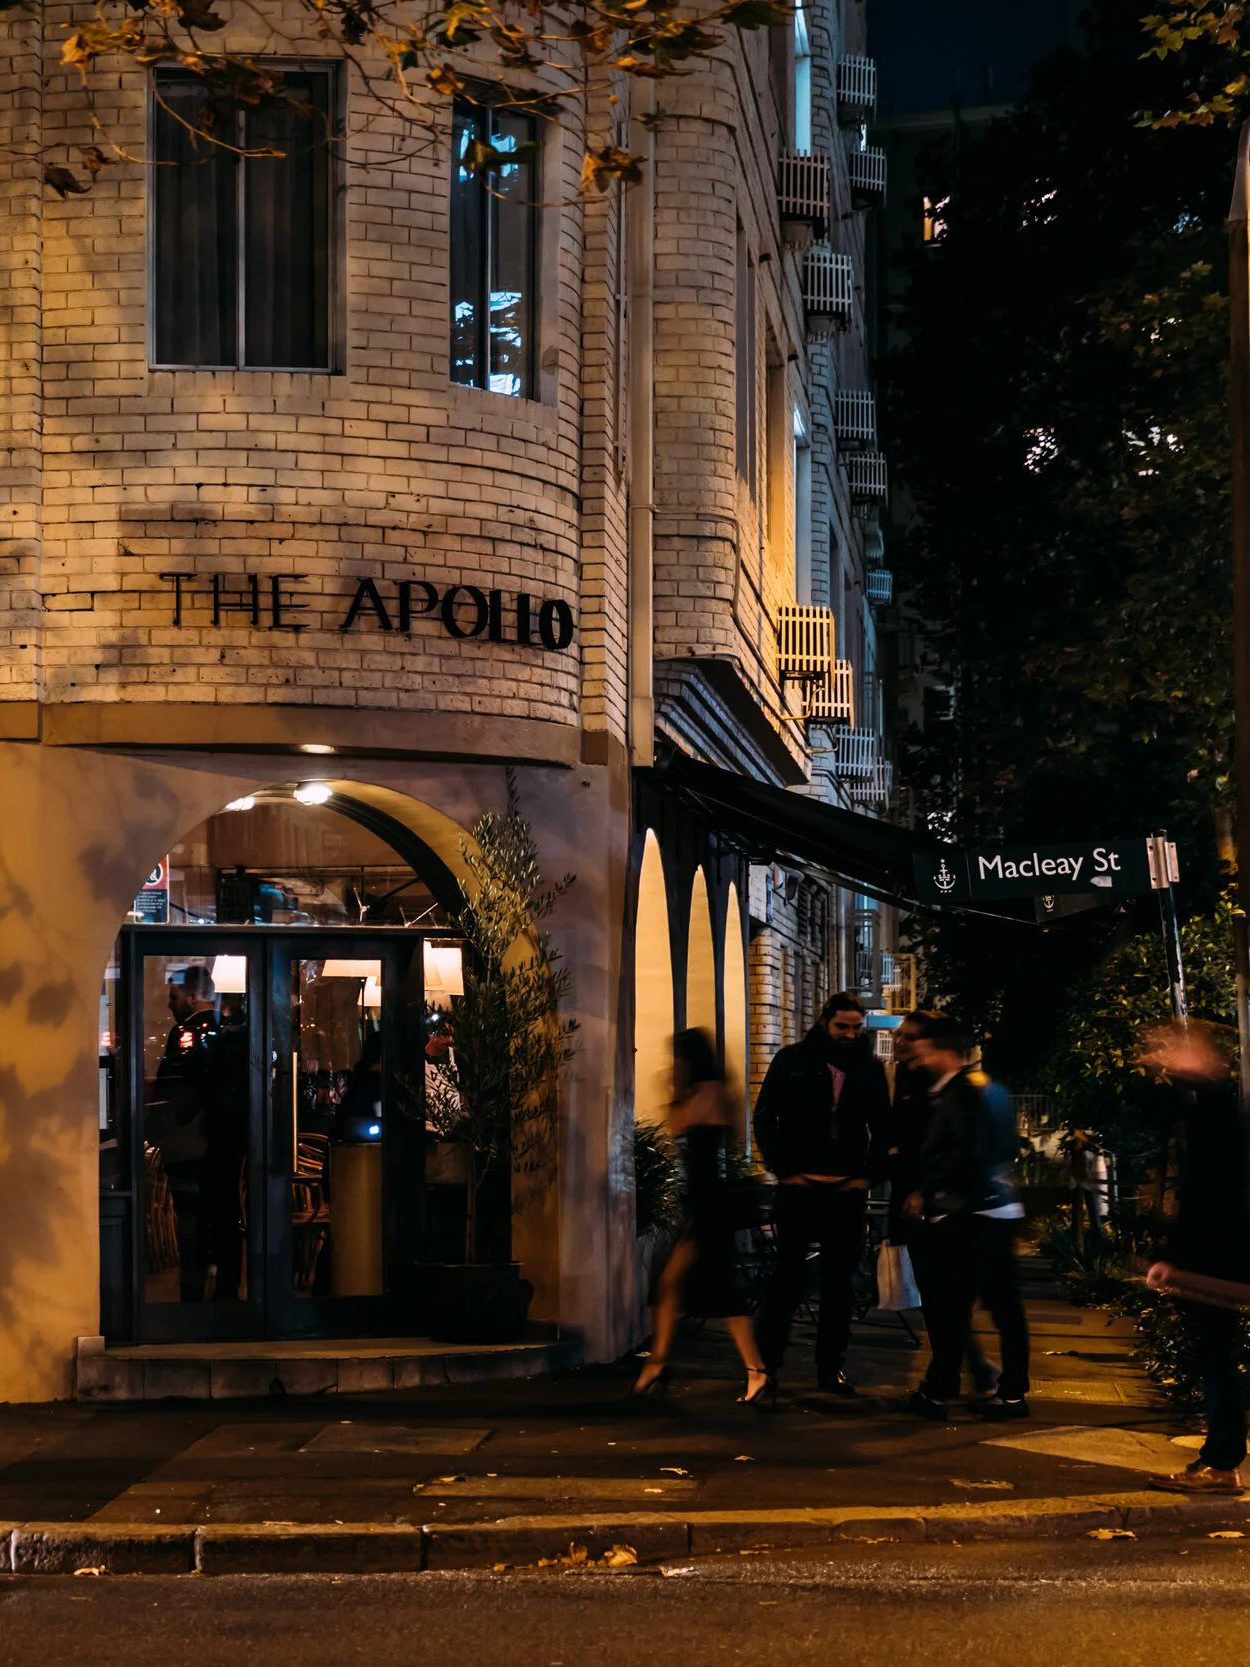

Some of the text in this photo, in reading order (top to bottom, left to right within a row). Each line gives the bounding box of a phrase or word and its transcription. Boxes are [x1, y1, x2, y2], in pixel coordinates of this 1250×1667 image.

[159, 572, 574, 650] THE APOLLO
[978, 848, 1121, 881] Macleay St
